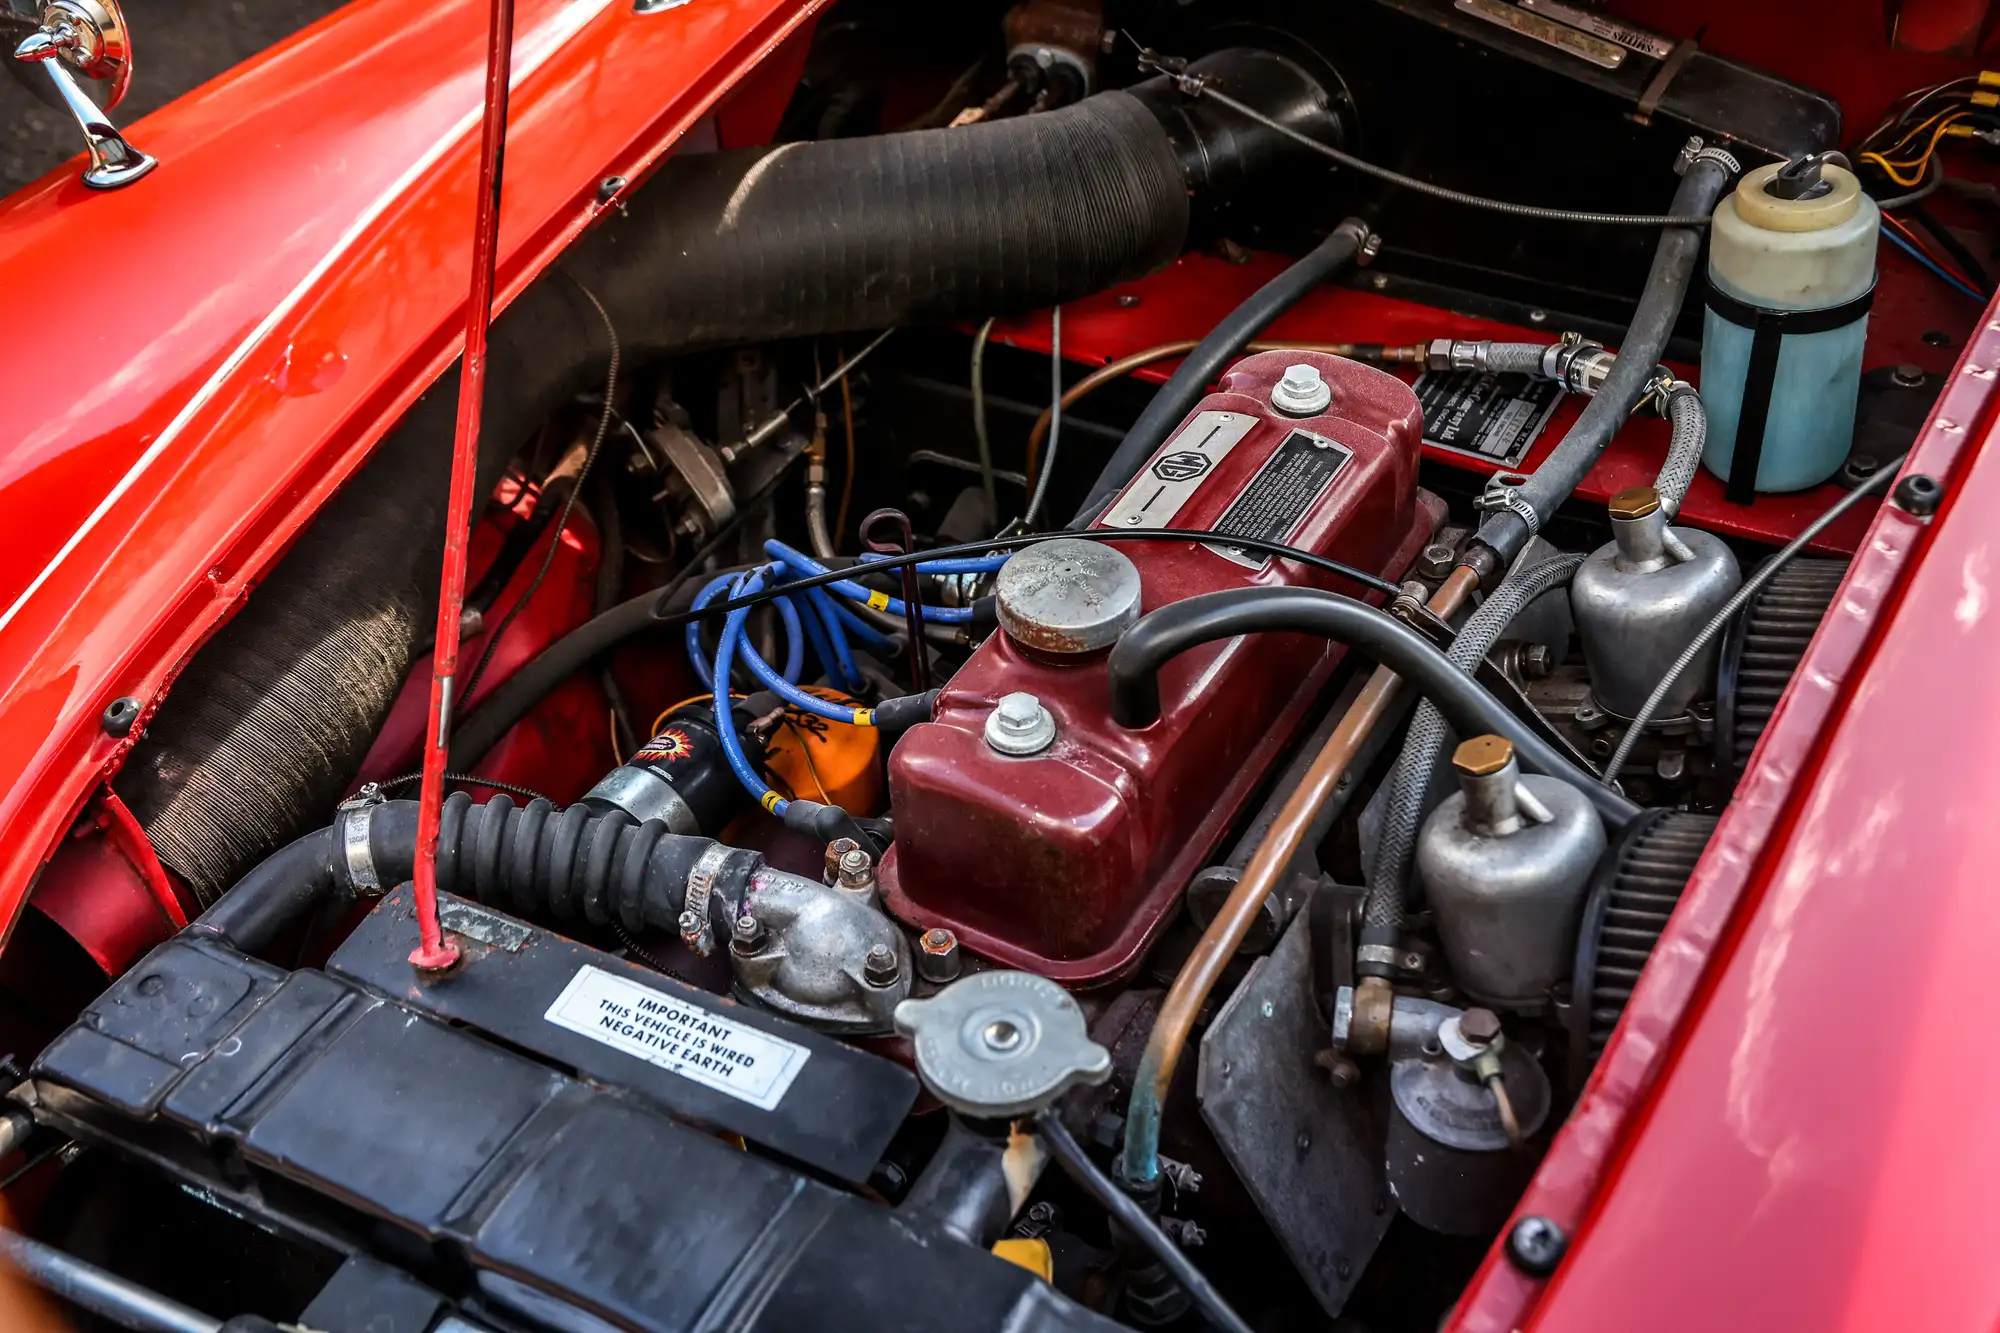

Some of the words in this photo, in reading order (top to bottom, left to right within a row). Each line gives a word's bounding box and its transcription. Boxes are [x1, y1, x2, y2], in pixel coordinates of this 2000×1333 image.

[599, 999, 630, 1024] THIS
[633, 1013, 690, 1043] VEHICLE
[691, 1035, 706, 1050] IS
[710, 1045, 755, 1069] WIRED
[600, 1015, 677, 1056] NEGATIVE
[680, 1049, 734, 1077] EARTH
[637, 997, 732, 1042] IMPORTANT
